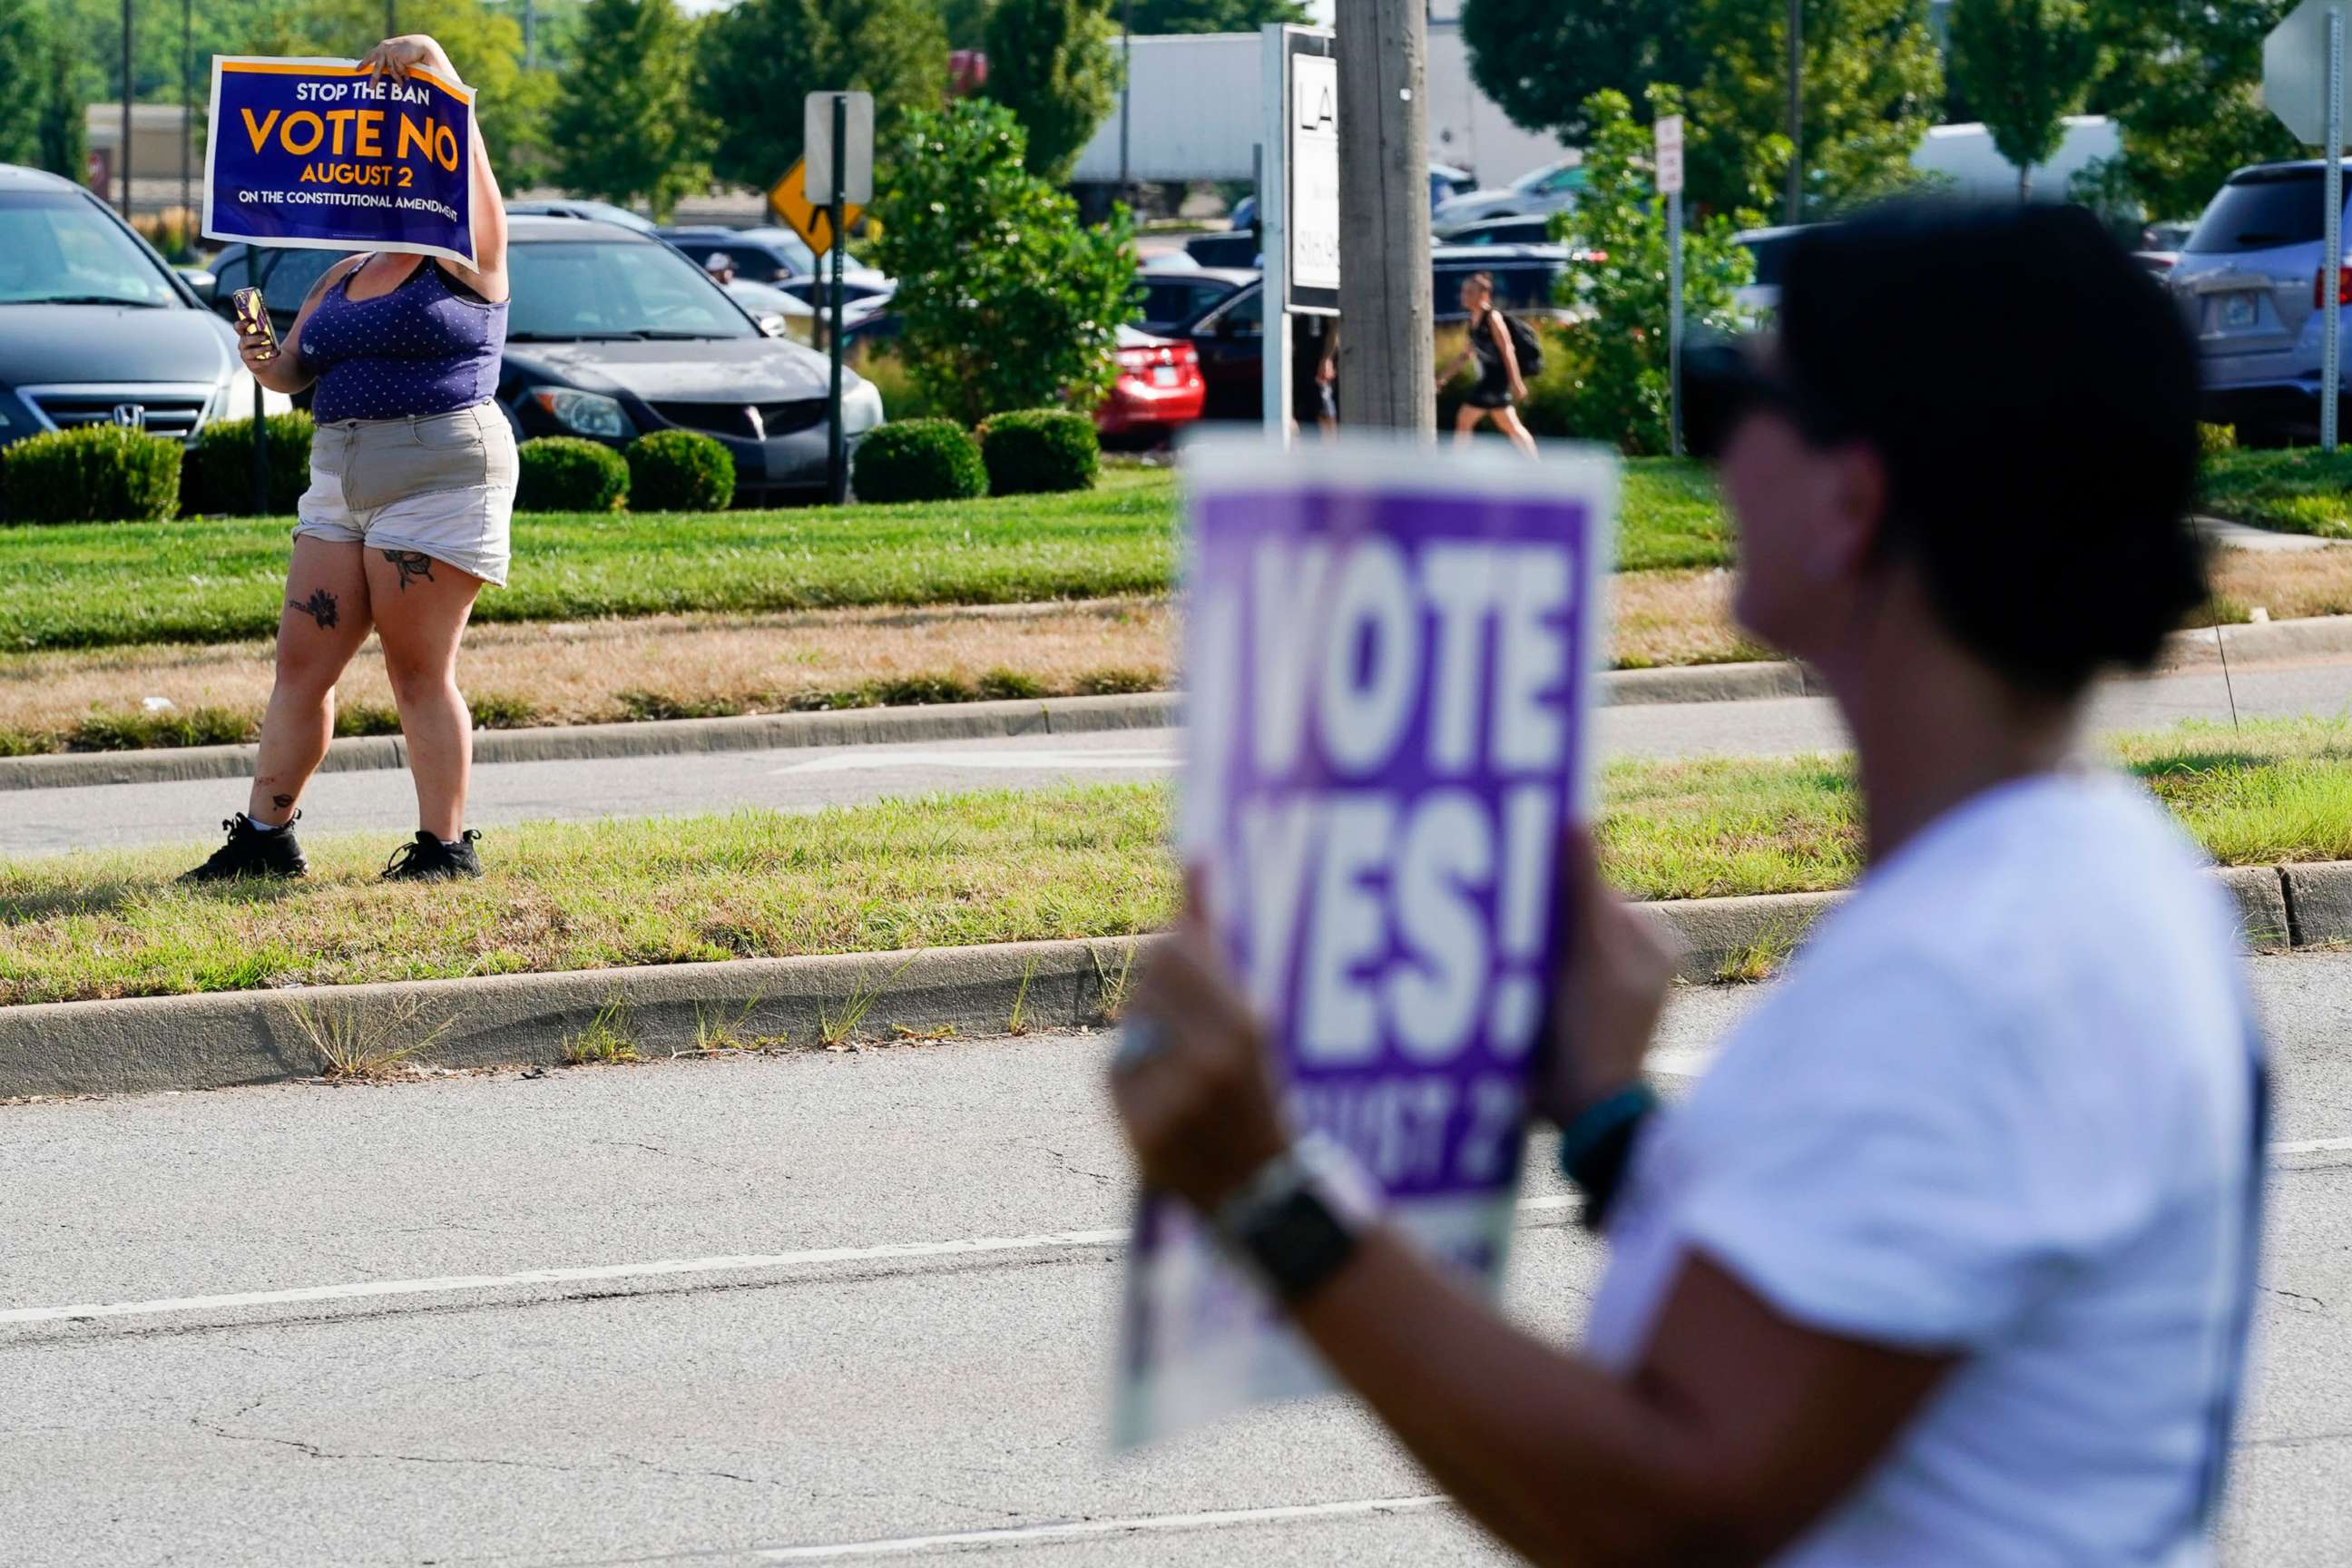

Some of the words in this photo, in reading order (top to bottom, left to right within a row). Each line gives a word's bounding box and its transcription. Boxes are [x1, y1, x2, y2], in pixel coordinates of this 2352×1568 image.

[296, 83, 348, 102] STOP
[352, 81, 387, 100] THE
[390, 83, 430, 106] BAN
[240, 108, 385, 156] VOTE
[397, 112, 458, 172] NO
[299, 162, 393, 186] AUGUST
[397, 166, 414, 187] 2
[239, 191, 259, 203] ON
[261, 191, 284, 204] THE
[286, 191, 392, 208] CONSTITUTIONAL
[395, 197, 458, 222] AMENDMENT
[1247, 537, 1572, 777] VOTE
[1234, 788, 1557, 1063] YES!
